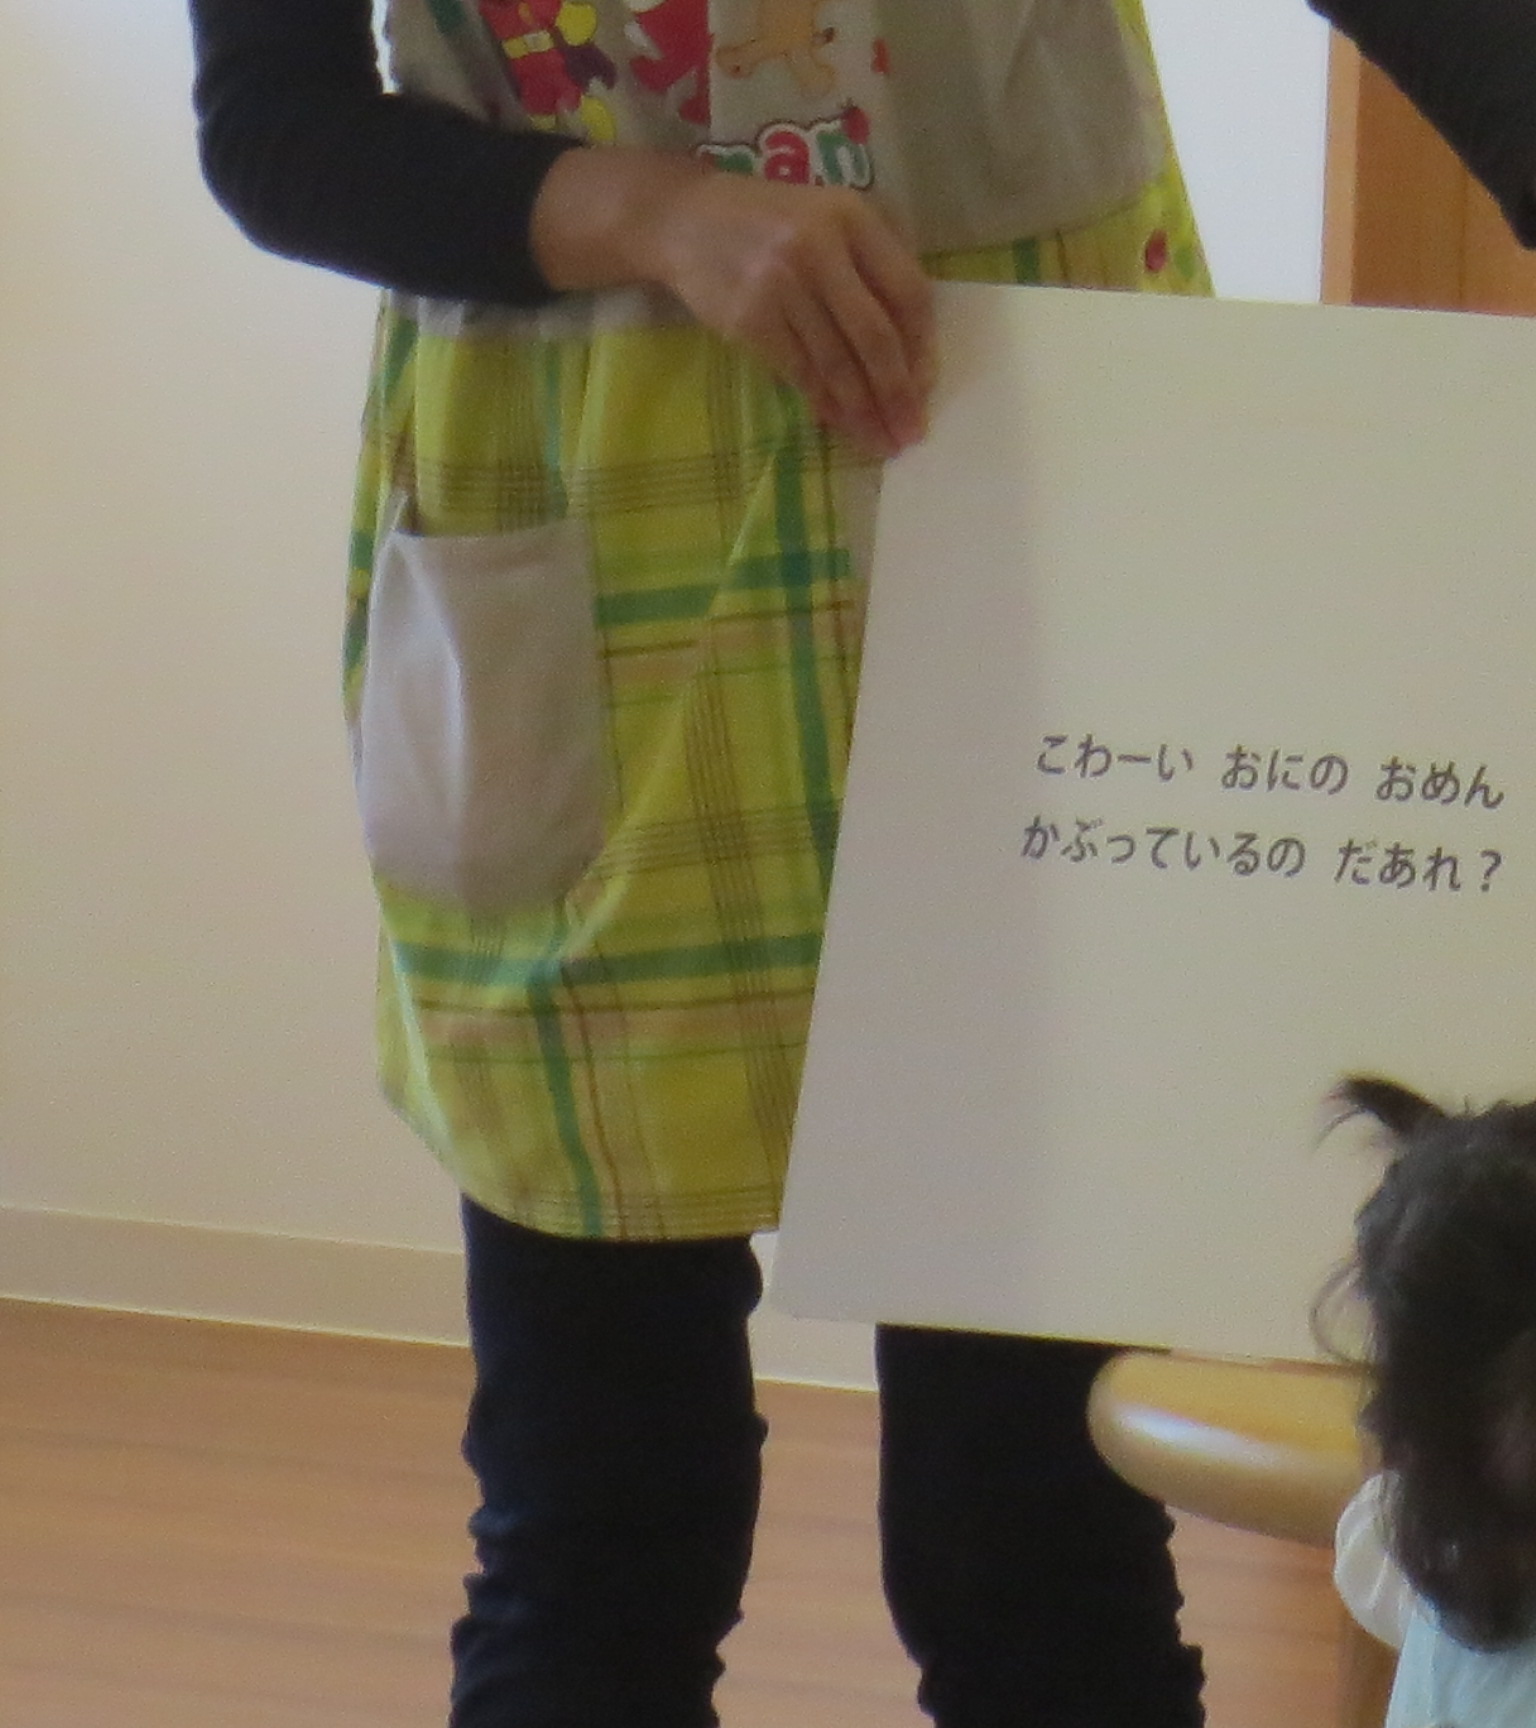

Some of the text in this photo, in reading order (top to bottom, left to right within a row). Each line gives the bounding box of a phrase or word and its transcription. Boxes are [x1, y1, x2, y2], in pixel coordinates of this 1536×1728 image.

[1035, 733, 1504, 809] こわーい おにの おめん
[1020, 814, 1306, 878] かぶっているの
